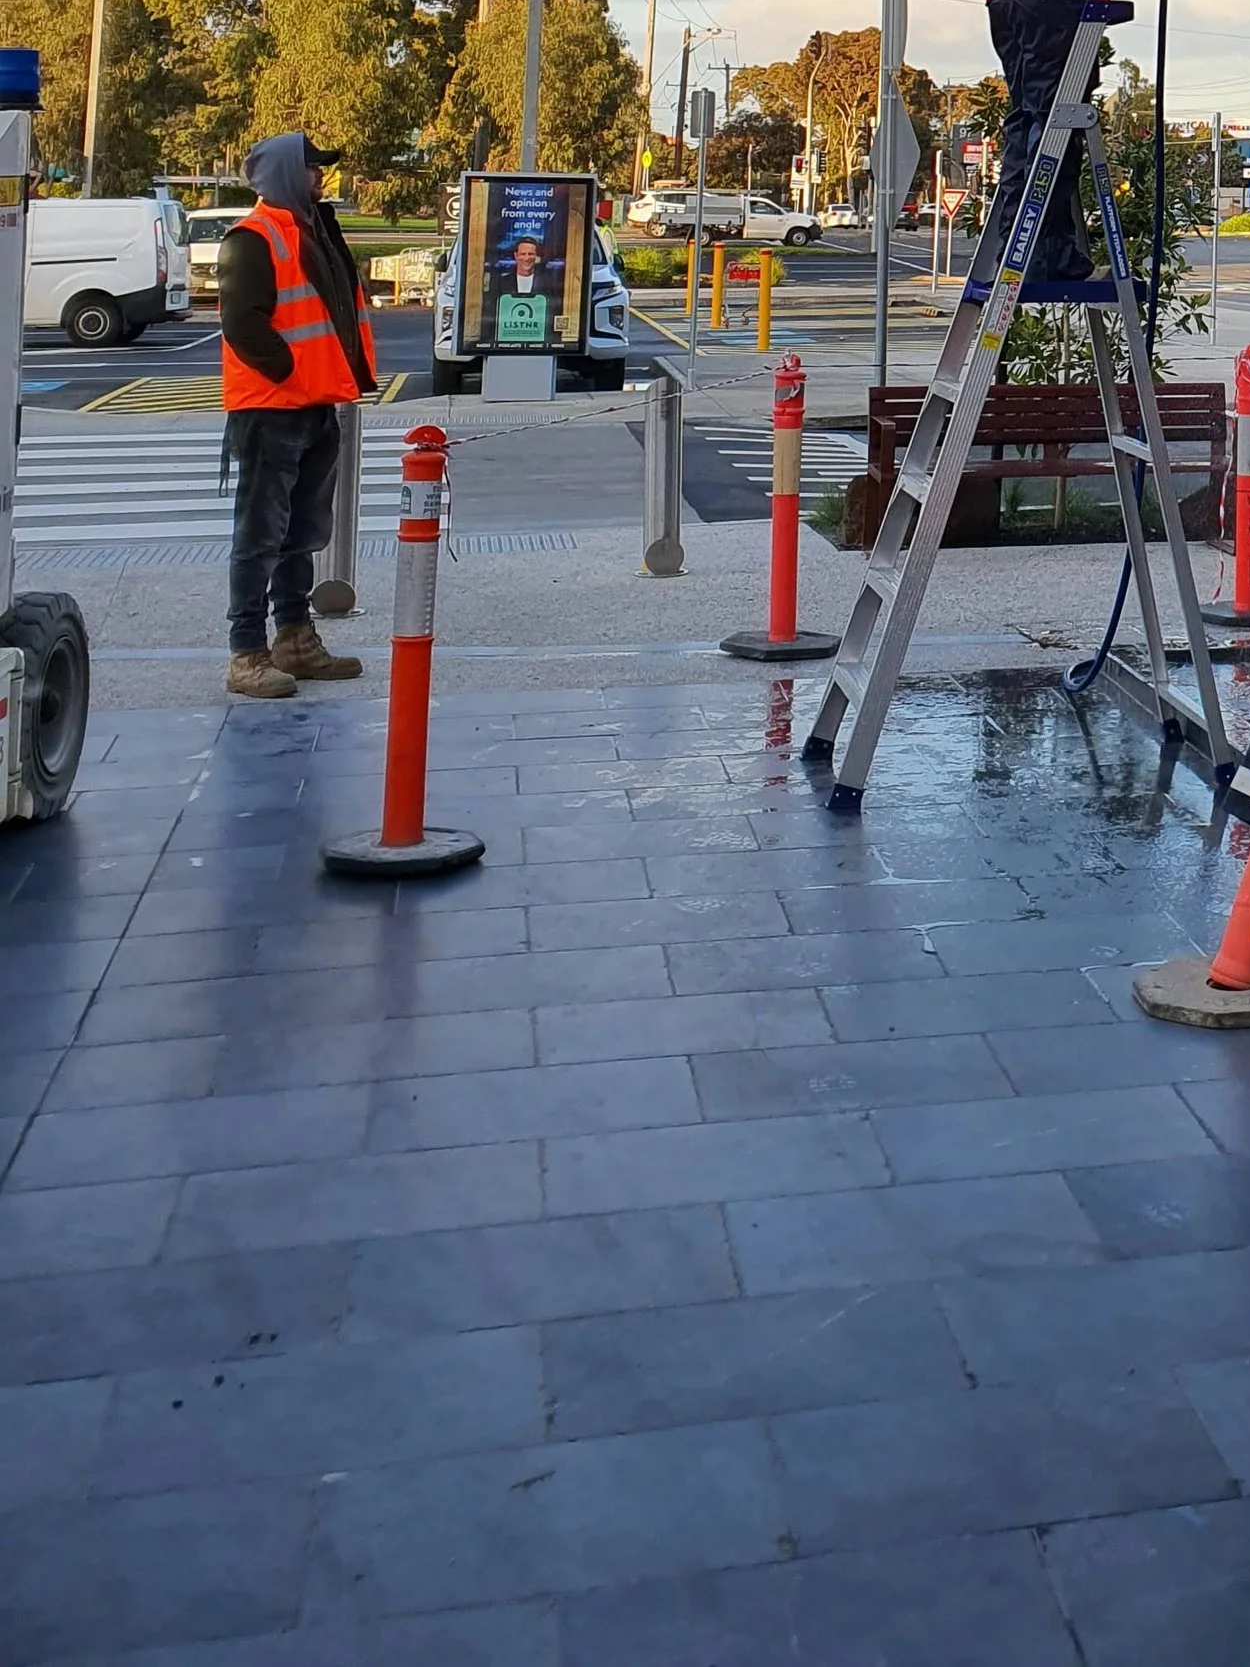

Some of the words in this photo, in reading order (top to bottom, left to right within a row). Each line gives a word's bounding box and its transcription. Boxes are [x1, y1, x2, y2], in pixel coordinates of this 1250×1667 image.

[505, 186, 533, 196] News
[535, 187, 554, 197] and
[510, 198, 548, 209] opinion
[501, 208, 525, 218] from
[527, 211, 556, 221] every
[1012, 207, 1037, 263] BAILEY
[1029, 159, 1055, 204] P150
[514, 219, 541, 231] angle
[1105, 196, 1117, 232] PLATFORM
[1112, 233, 1126, 277] STEPLADDER
